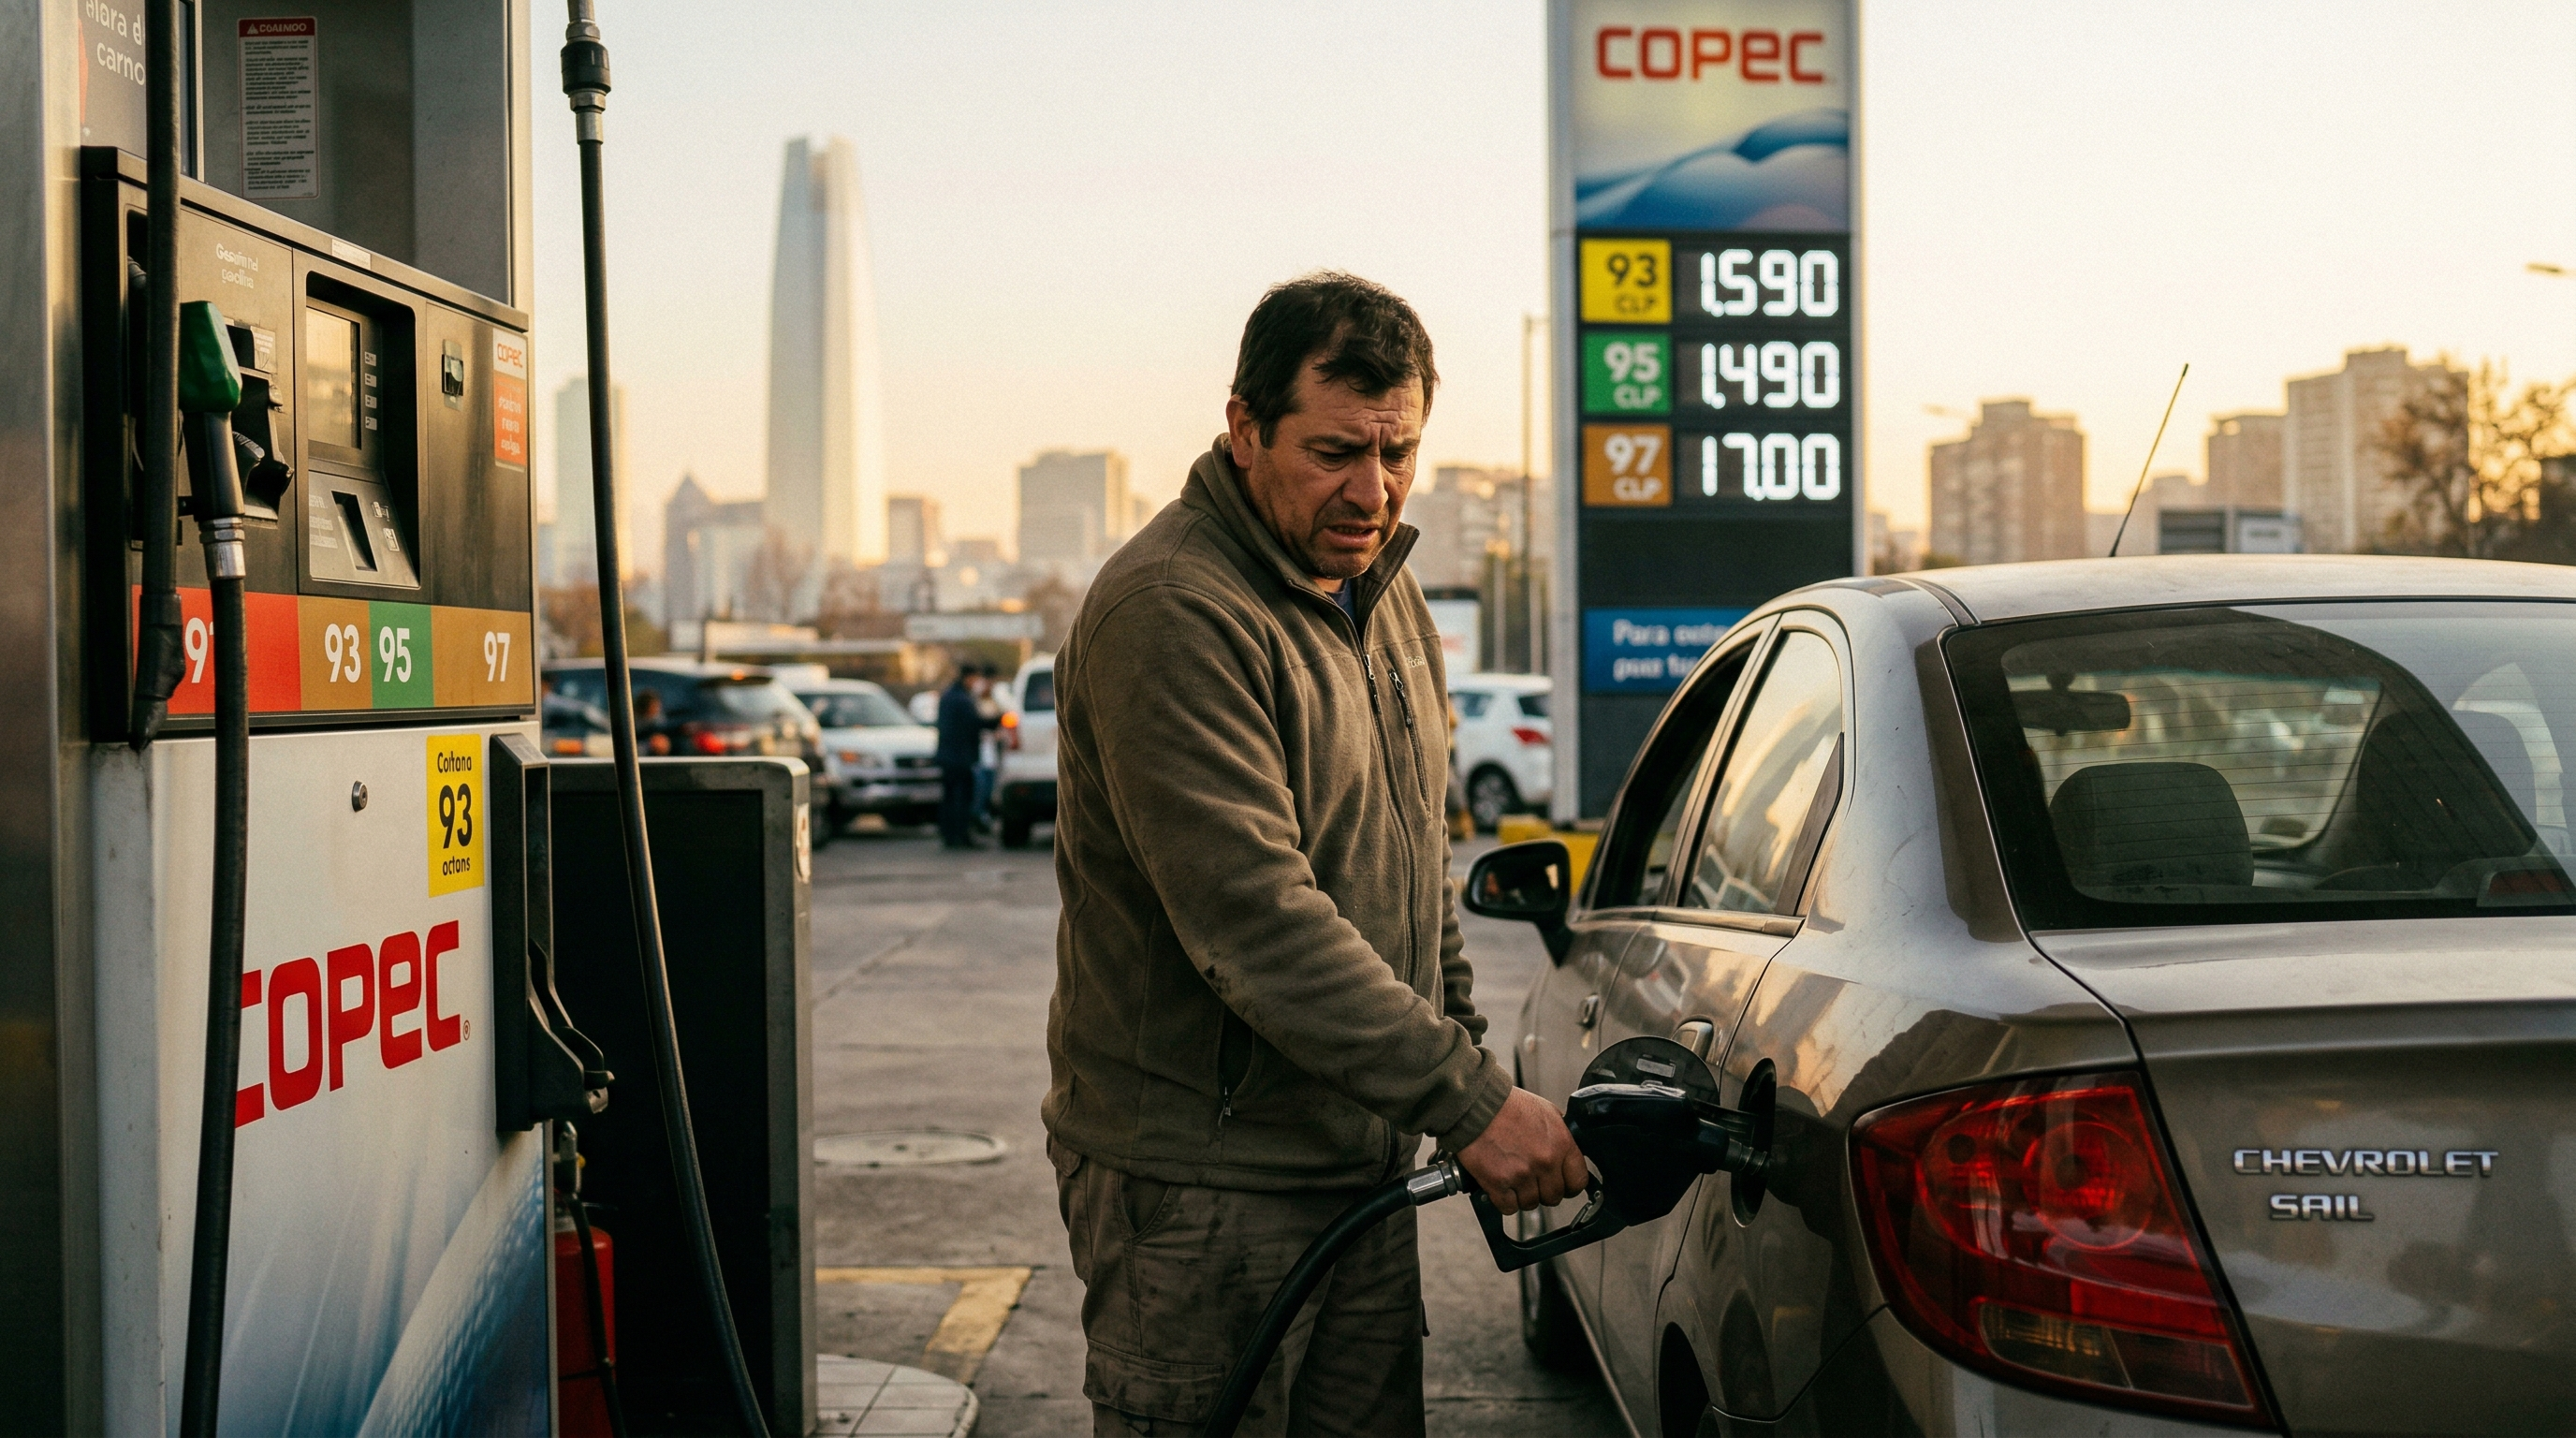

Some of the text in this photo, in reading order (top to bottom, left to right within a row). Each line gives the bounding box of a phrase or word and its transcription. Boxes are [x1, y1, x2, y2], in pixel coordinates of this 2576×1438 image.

[96, 42, 145, 85] carno
[1607, 253, 1657, 287] 93
[1700, 248, 1839, 317] 1.590
[1603, 341, 1661, 383] 95
[1701, 341, 1840, 409] 1.490
[1614, 384, 1661, 409] CLP
[1604, 433, 1662, 476] 97
[1702, 433, 1840, 501] 17.00
[1613, 477, 1662, 501] CLP
[185, 617, 213, 683] 9
[325, 624, 412, 682] 93 95
[484, 632, 510, 682] 97
[439, 783, 473, 849] 93
[2233, 1149, 2499, 1177] CHEVROLET
[2270, 1194, 2375, 1221] SAIL
